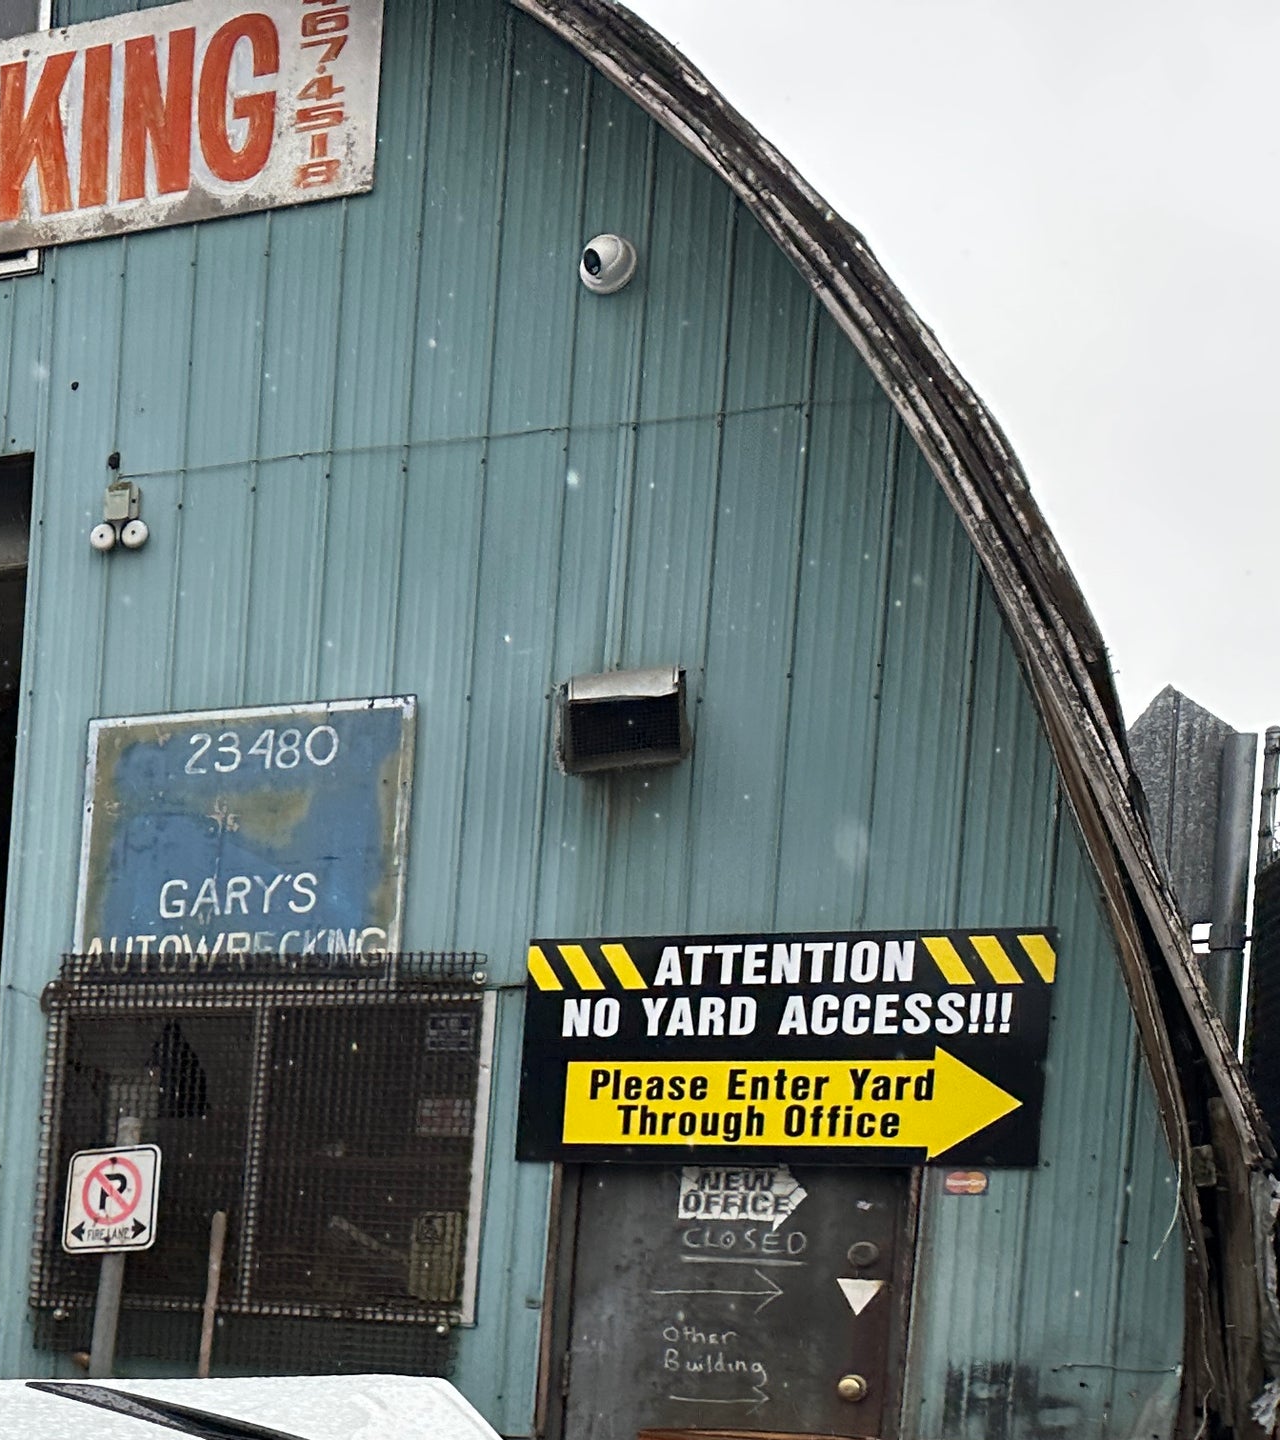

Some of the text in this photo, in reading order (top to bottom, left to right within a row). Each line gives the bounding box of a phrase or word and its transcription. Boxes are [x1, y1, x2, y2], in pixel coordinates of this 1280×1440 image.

[184, 724, 340, 775] 23480
[158, 871, 319, 919] GARY'S
[652, 940, 916, 987] ATTENTION
[561, 992, 1014, 1038] NO YARD ACCESS!!!
[589, 1067, 936, 1101] Please Enter Yard
[617, 1104, 902, 1143] Through Office
[698, 1171, 775, 1192] NEW
[682, 1192, 792, 1215] OFFICE
[87, 1226, 131, 1241] FIRE LANE
[681, 1227, 808, 1254] CLOSED
[662, 1326, 739, 1346] Other
[663, 1348, 768, 1387] Building
